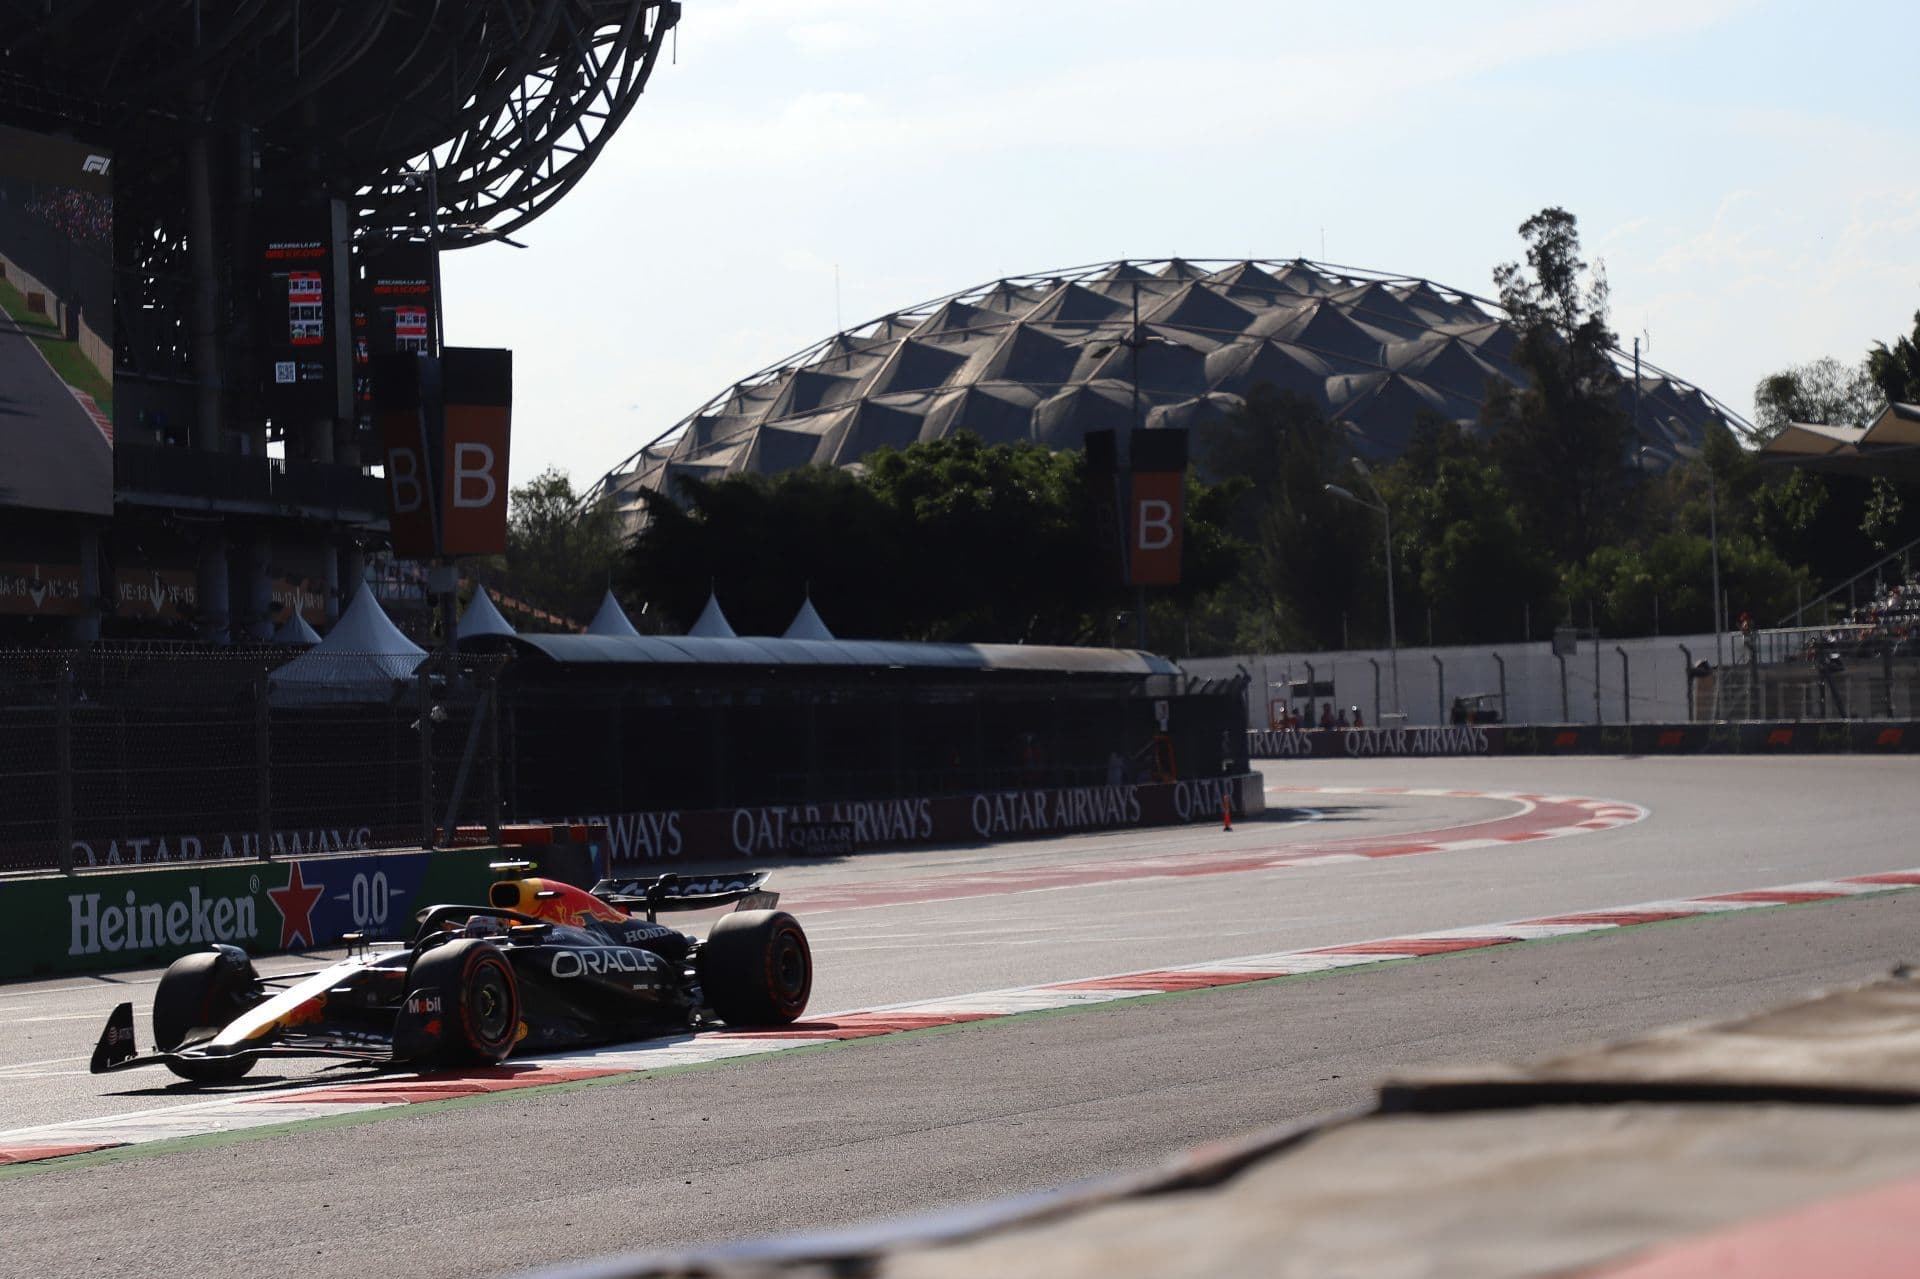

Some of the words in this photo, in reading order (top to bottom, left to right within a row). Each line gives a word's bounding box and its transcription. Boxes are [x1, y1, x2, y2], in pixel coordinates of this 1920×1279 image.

[388, 447, 422, 513] B
[453, 442, 496, 508] B
[1139, 499, 1174, 550] B
[1249, 730, 1312, 754] IRWAYS
[1344, 730, 1407, 754] QATAR
[1411, 727, 1488, 752] AIRWAYS
[603, 812, 682, 859] WAYS
[973, 791, 1048, 837] QATAR
[1053, 784, 1141, 826] AIRWAYS
[68, 886, 259, 956] Heineken
[352, 871, 388, 927] 0.0
[551, 949, 658, 978] ORACLE
[408, 996, 441, 1014] Mobil
